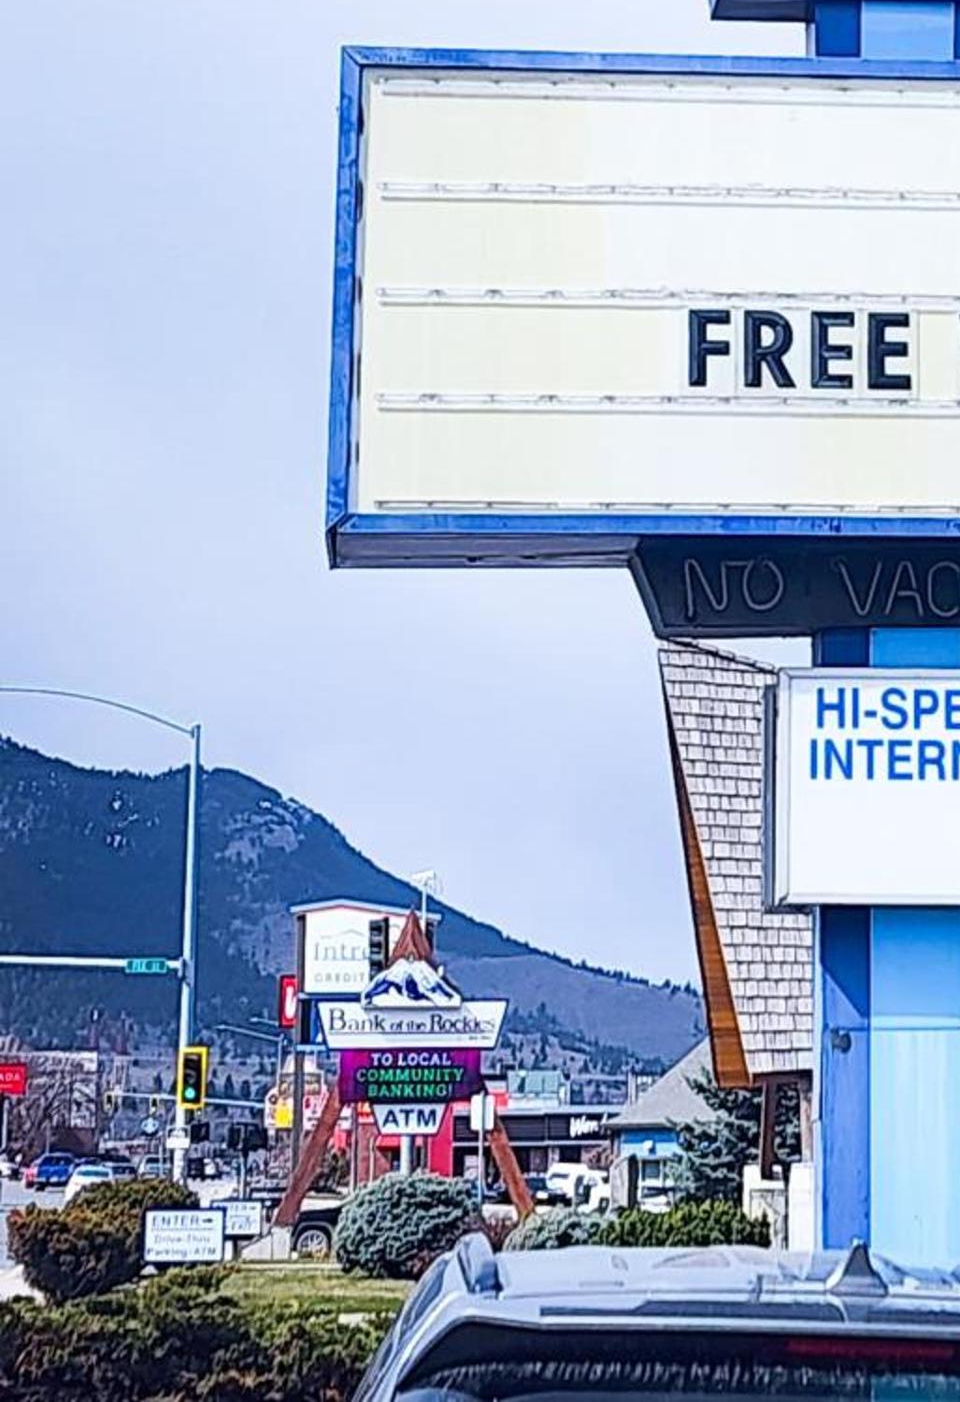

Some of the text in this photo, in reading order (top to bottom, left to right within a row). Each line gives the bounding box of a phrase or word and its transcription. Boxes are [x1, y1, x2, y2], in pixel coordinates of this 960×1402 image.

[688, 309, 912, 391] FREE
[684, 557, 785, 618] NO
[329, 1007, 386, 1031] Bank
[389, 1019, 403, 1031] of
[406, 1019, 427, 1031] the
[371, 1052, 451, 1066] TO LOCAL
[356, 1068, 464, 1083] COMMUNITY
[382, 1109, 437, 1128] ATM
[152, 1213, 200, 1227] ENTER
